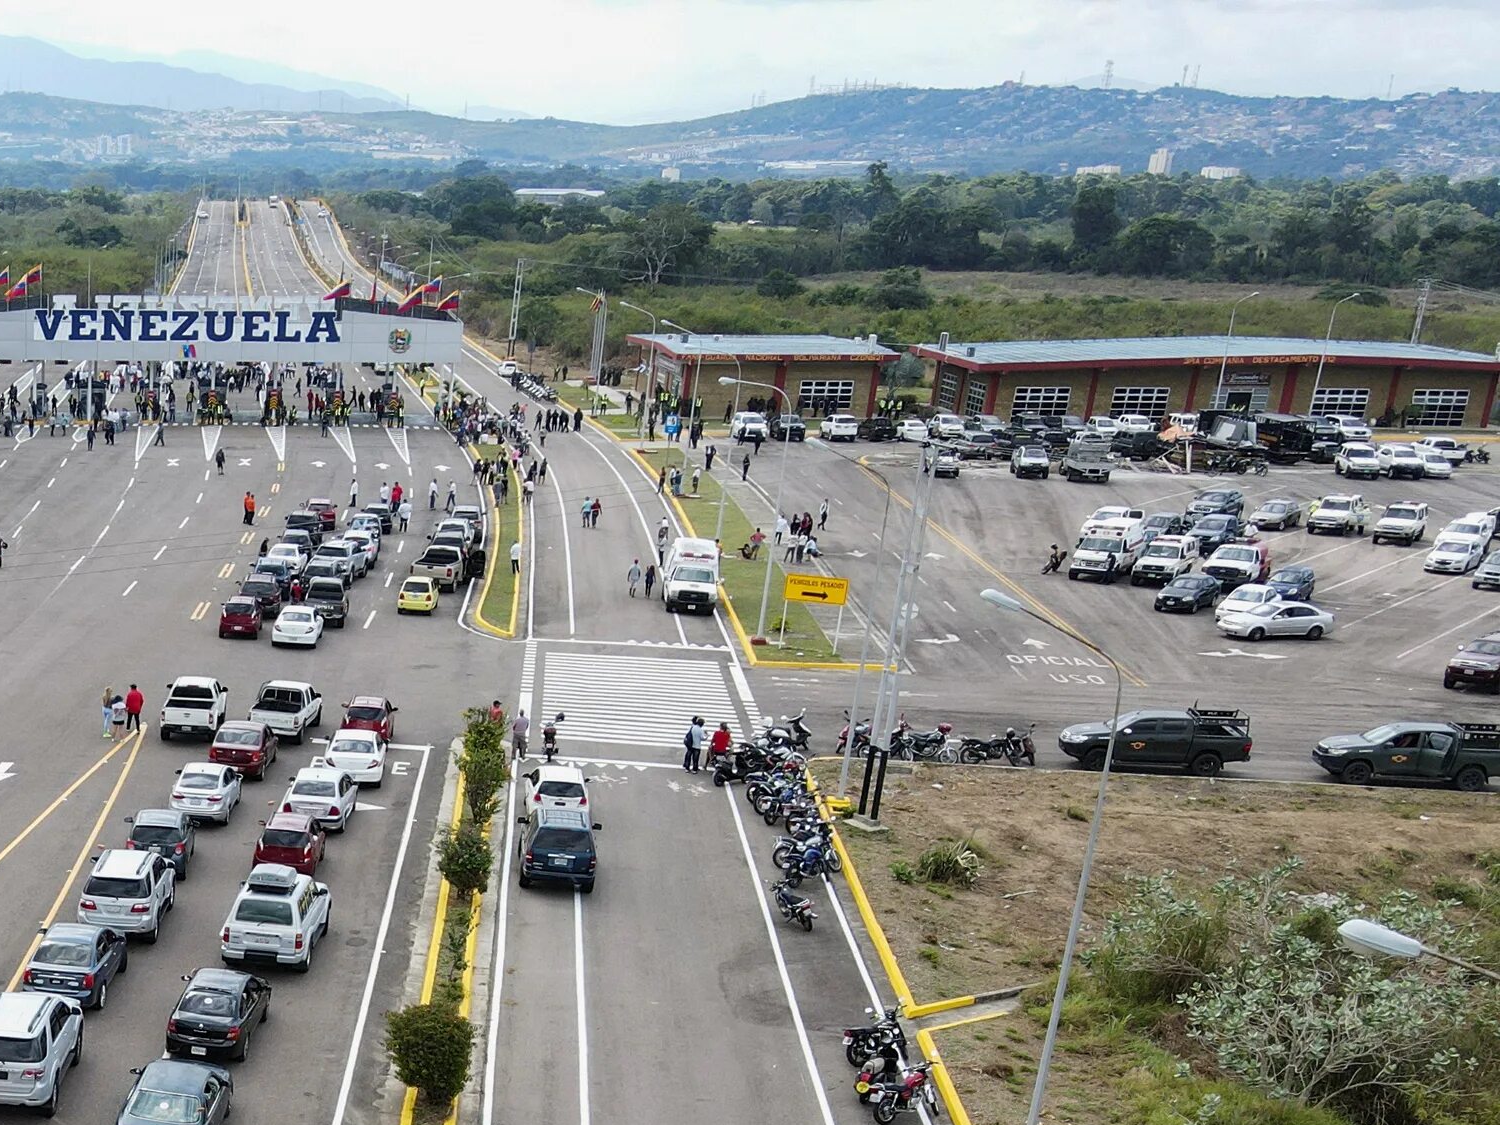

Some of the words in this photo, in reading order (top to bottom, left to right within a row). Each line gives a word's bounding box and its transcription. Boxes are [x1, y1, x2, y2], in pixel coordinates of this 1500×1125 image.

[35, 309, 340, 342] VENEZUELA
[1252, 355, 1319, 363] DESTACAMENTO
[820, 580, 844, 589] PESADOS
[1006, 654, 1110, 668] OFICIAL
[1049, 673, 1106, 685] USO
